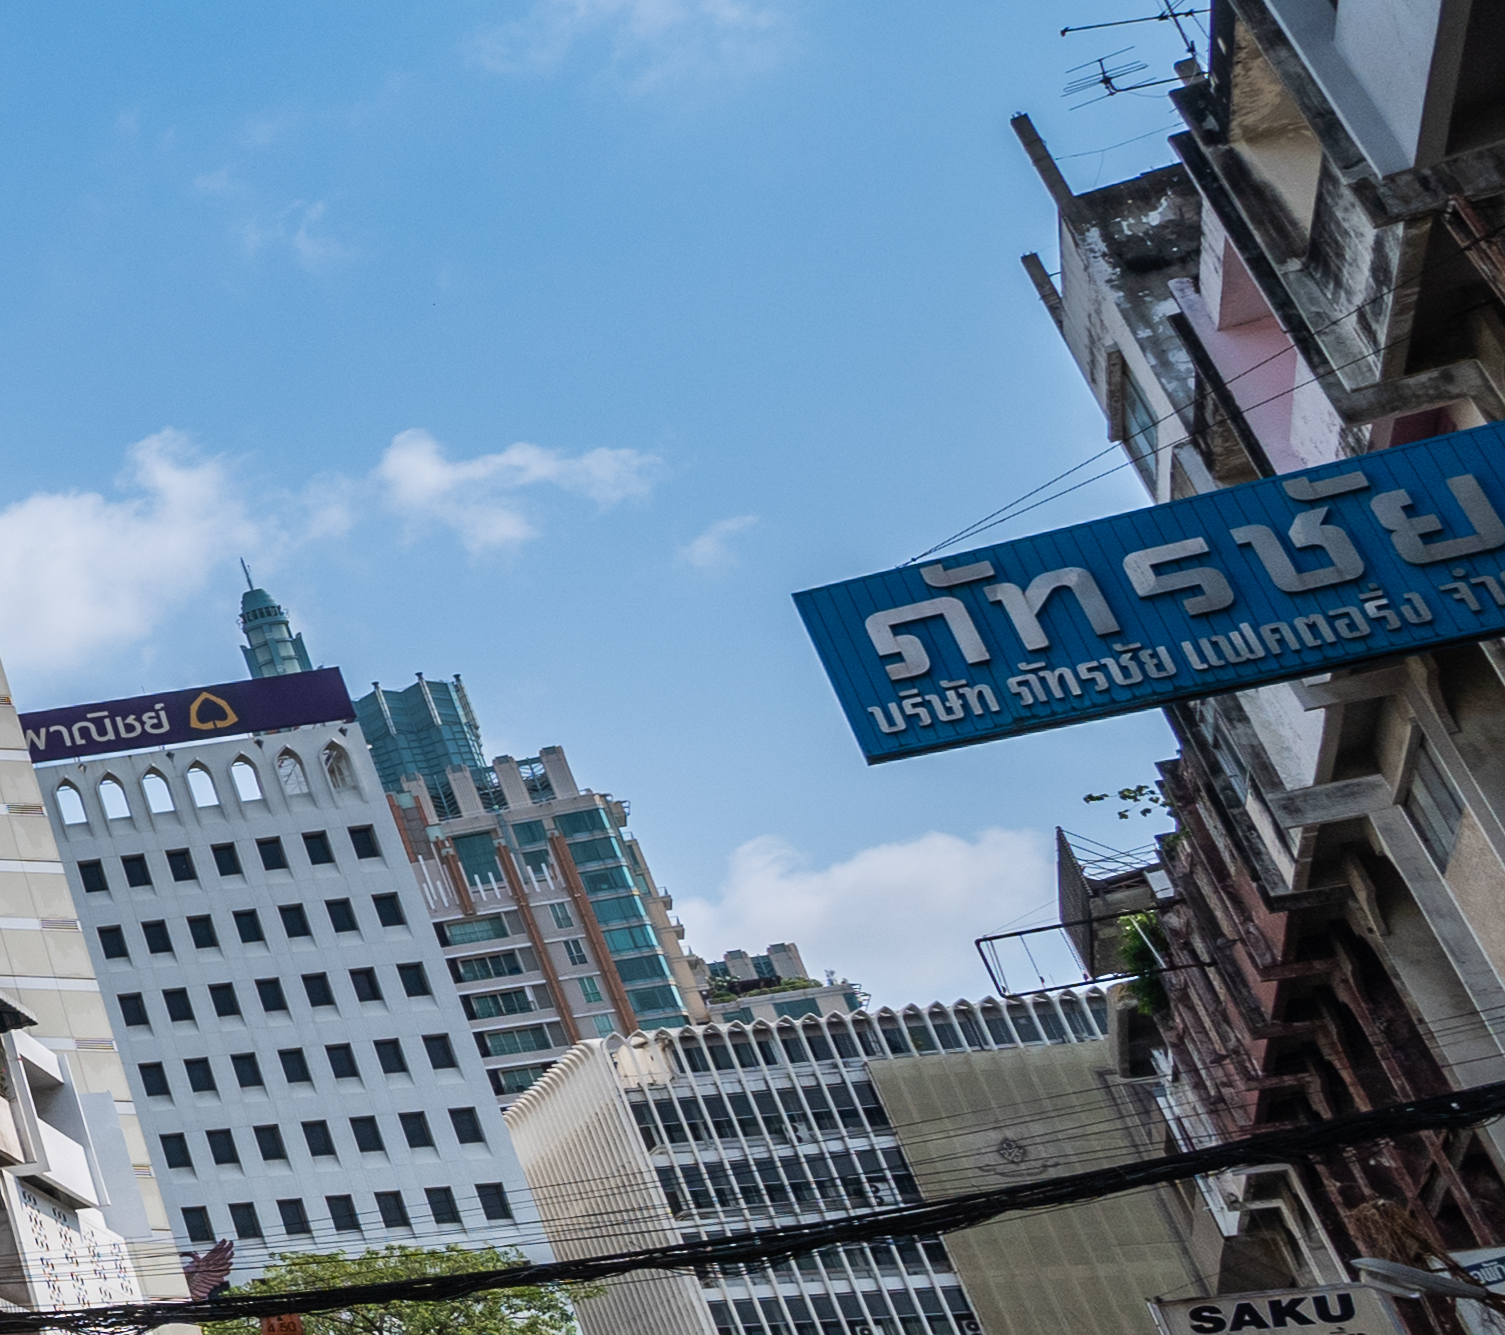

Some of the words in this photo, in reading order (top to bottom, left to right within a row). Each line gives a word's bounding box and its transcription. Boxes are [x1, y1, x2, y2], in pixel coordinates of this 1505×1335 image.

[868, 678, 1001, 735] บริษัท
[1006, 642, 1177, 707] ภัทรชัย
[1181, 582, 1433, 671] แฟคตอริ่ง
[1439, 567, 1505, 613] จำ
[26, 703, 171, 751] พาณิชย์
[1188, 1292, 1356, 1335] SAKU
